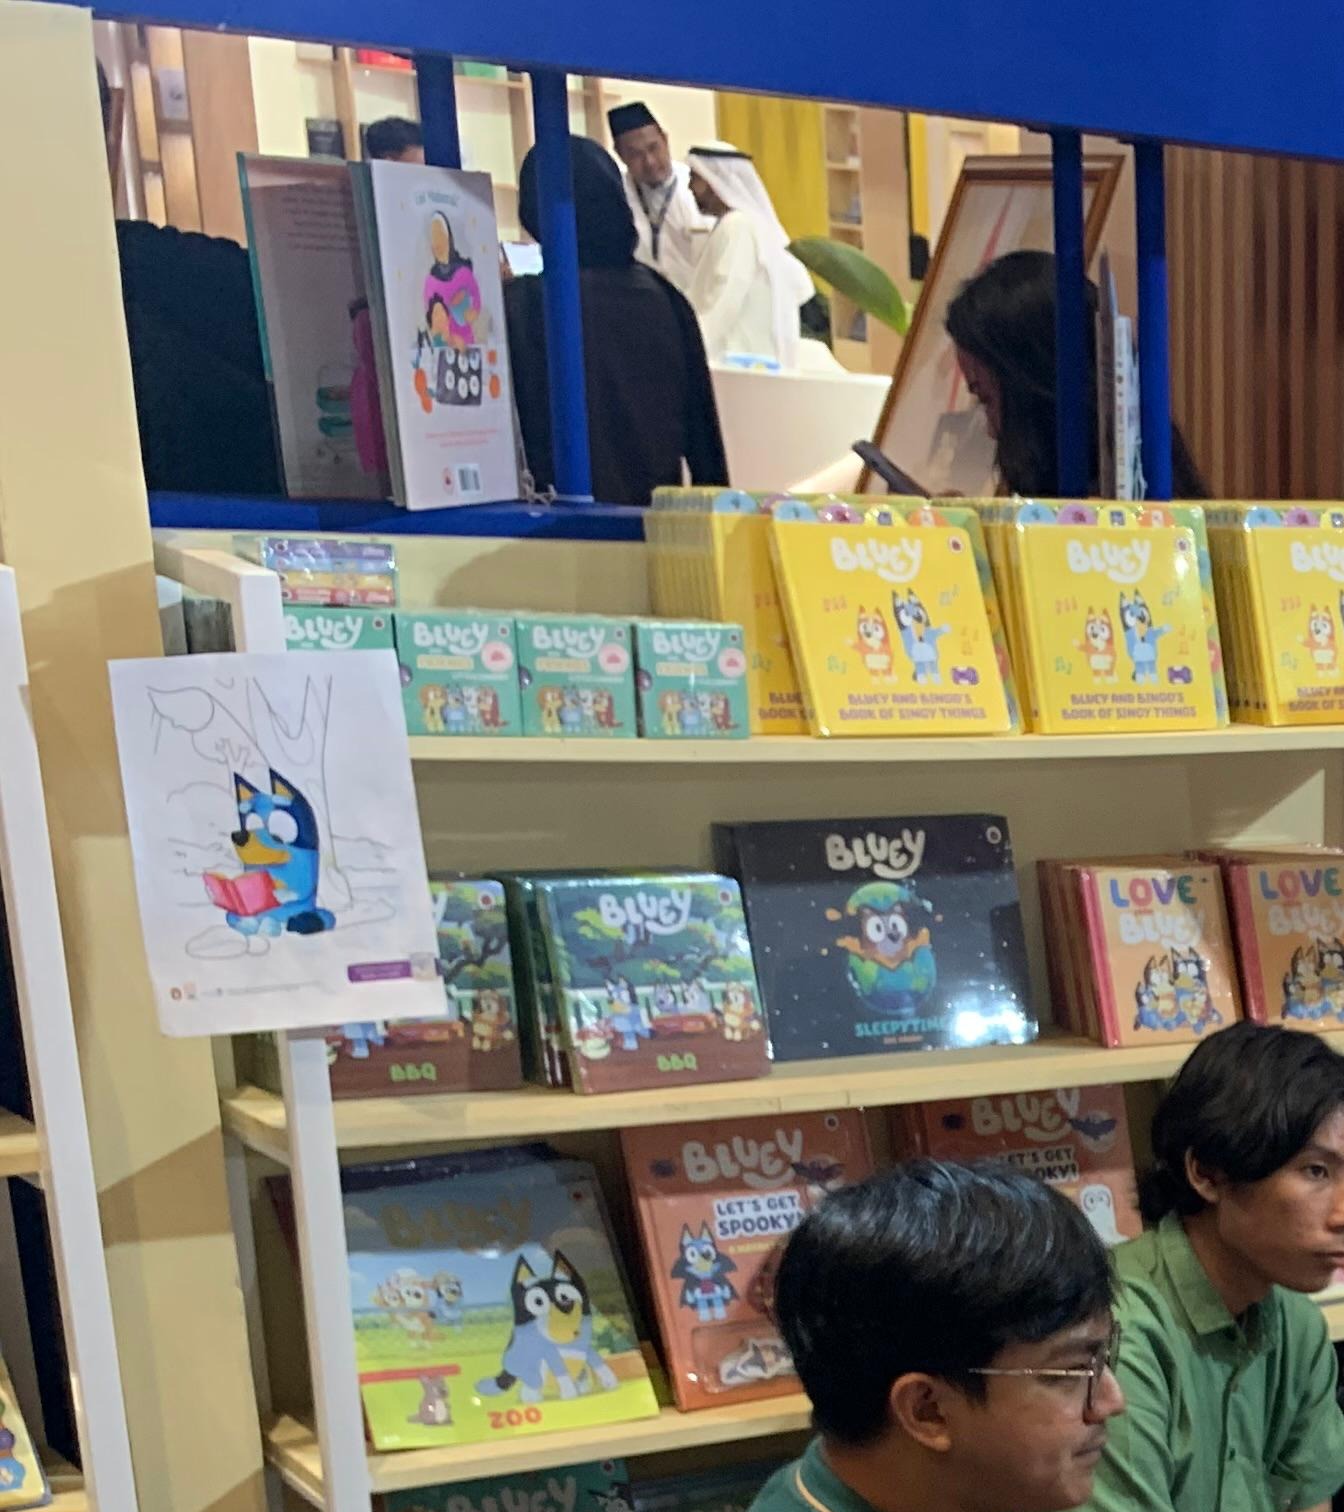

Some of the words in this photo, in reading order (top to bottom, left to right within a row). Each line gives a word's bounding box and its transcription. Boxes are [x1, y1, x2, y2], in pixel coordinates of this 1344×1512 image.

[1111, 876, 1198, 907] LOVE
[1259, 867, 1343, 900] LOVE
[767, 1196, 797, 1212] GET
[488, 1407, 542, 1429] ZOO
